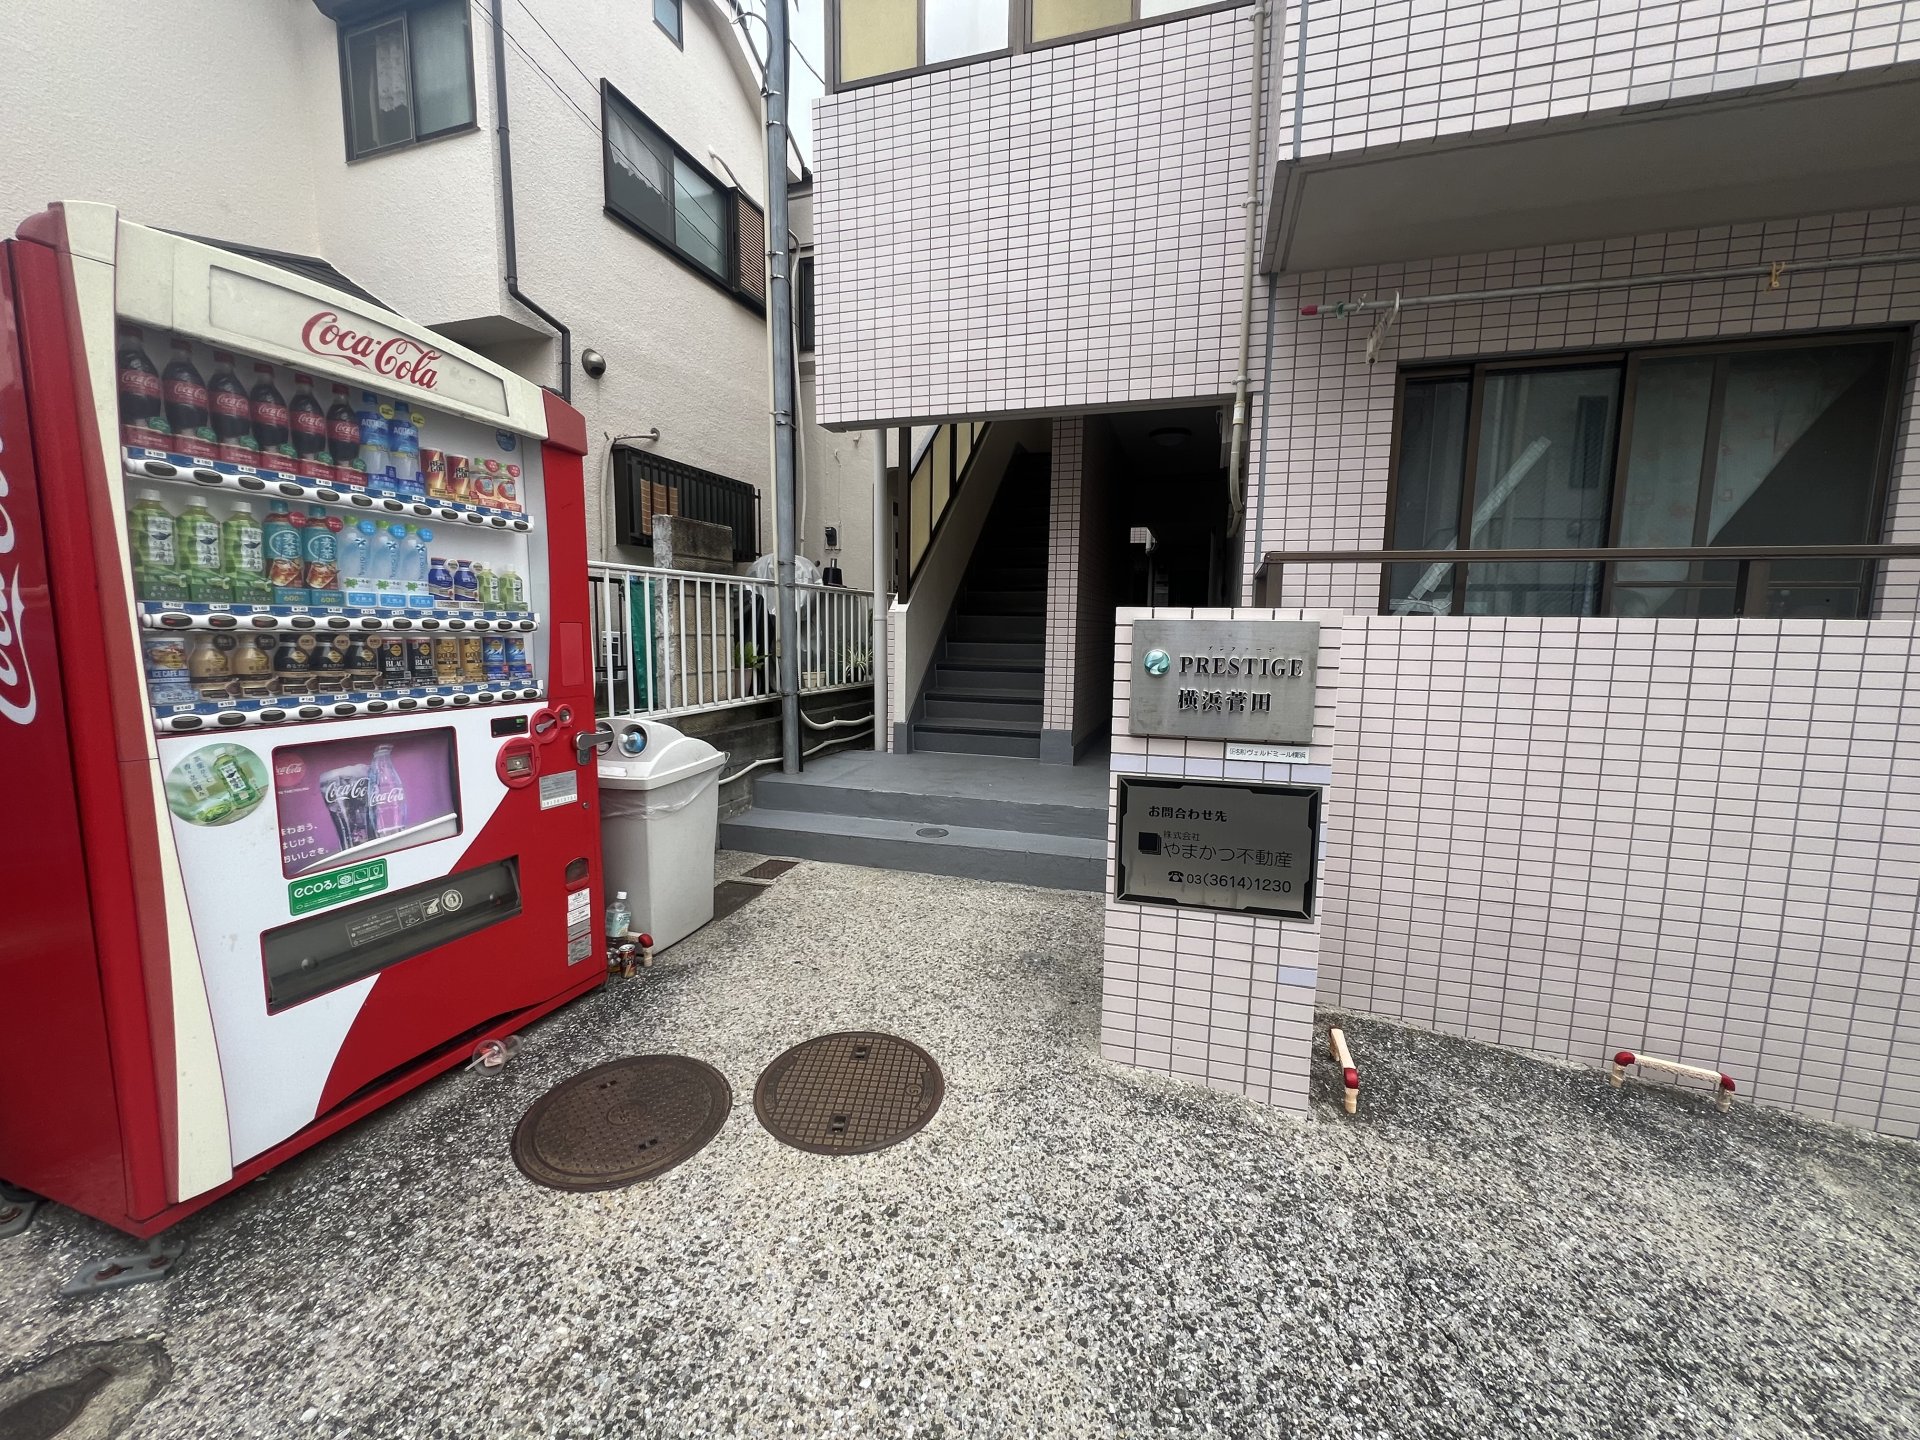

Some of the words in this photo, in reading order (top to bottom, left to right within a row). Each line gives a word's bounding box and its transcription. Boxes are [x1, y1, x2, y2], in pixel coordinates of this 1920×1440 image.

[301, 311, 442, 389] Coca-Cola
[283, 533, 296, 556] 麦茶
[320, 537, 333, 559] 麦茶
[1178, 655, 1304, 677] PRESTIGE
[1178, 687, 1272, 713] 横浜菅田
[276, 763, 302, 775] oca-Cola
[325, 777, 370, 803] Coca-Co
[1148, 805, 1228, 822] お問合わせ先
[1163, 830, 1201, 841] 株式会社
[1163, 842, 1293, 868] やまかつ不動産
[1186, 872, 1292, 893] 03(3614)1230
